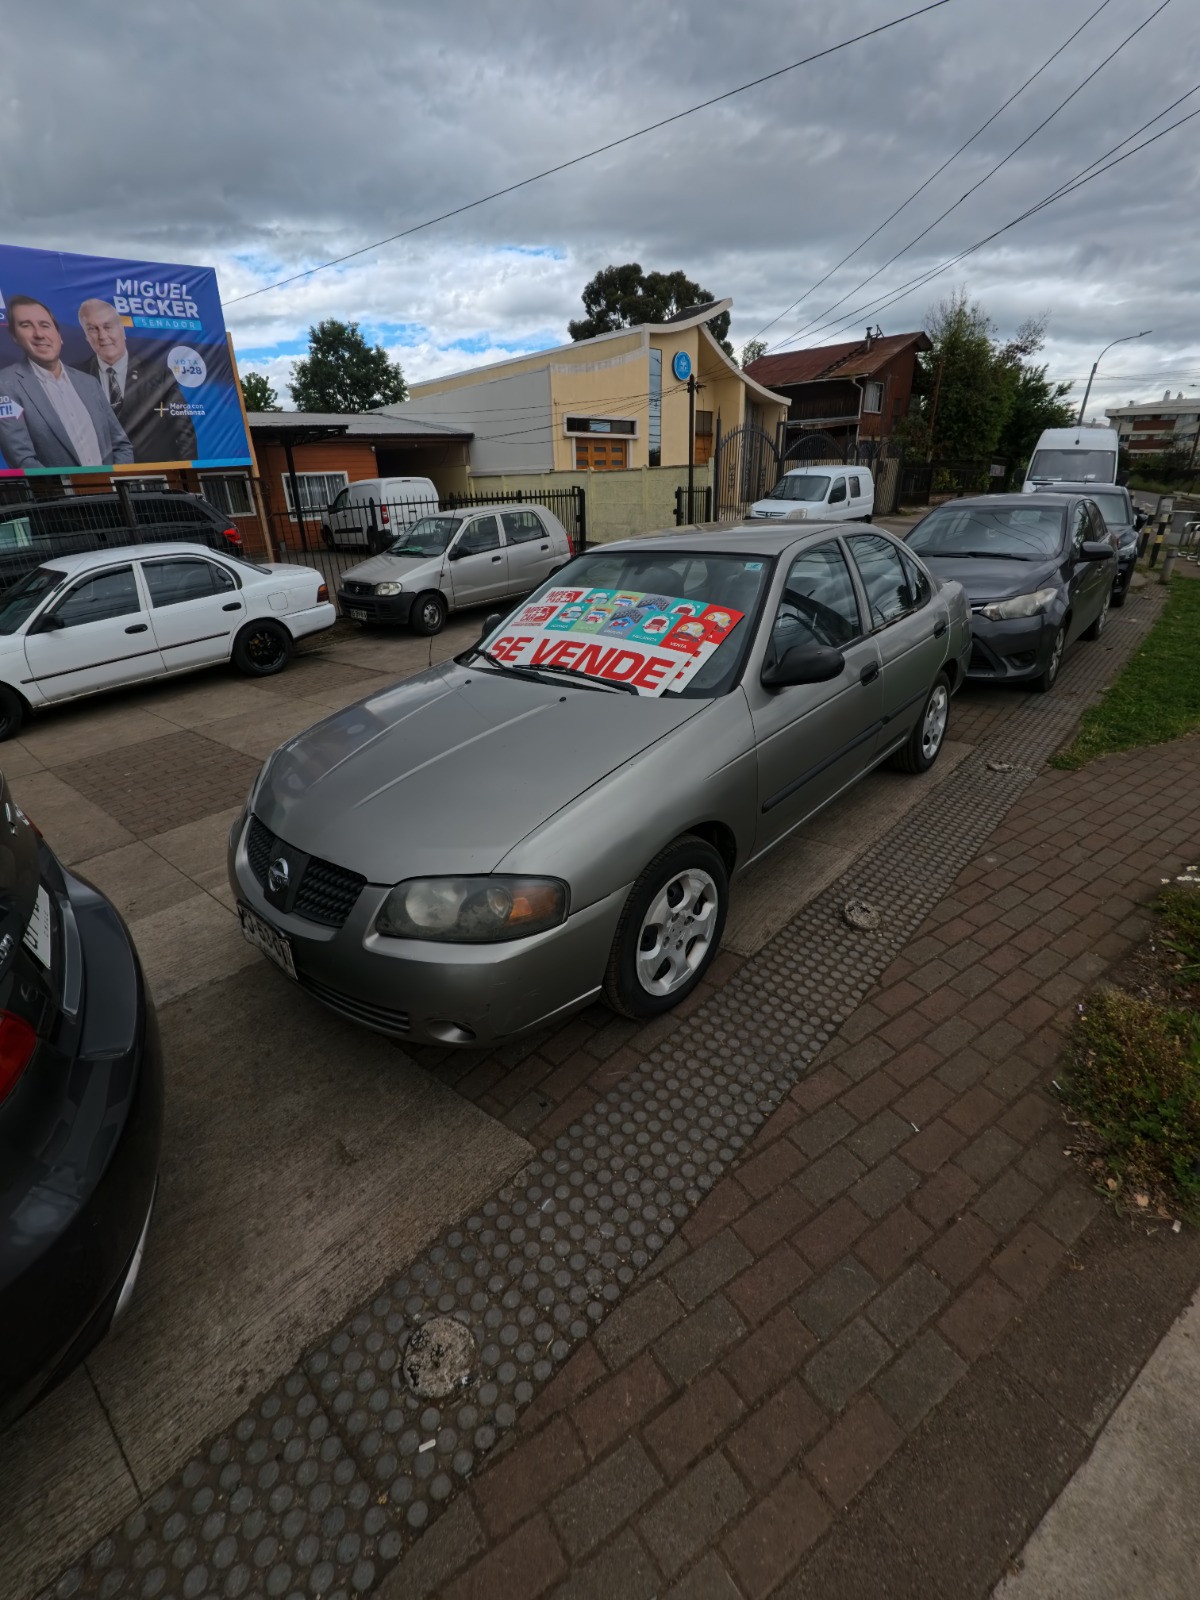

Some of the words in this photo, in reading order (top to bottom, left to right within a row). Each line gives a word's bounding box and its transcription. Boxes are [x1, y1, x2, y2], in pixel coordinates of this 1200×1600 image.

[116, 278, 192, 300] MIGUEL
[113, 296, 199, 318] BECKER
[141, 318, 195, 329] SENADOR
[174, 358, 199, 366] VOTA
[181, 366, 202, 375] J-28
[169, 402, 191, 410] Marca
[490, 636, 534, 661] SE
[529, 638, 677, 690] VENDE
